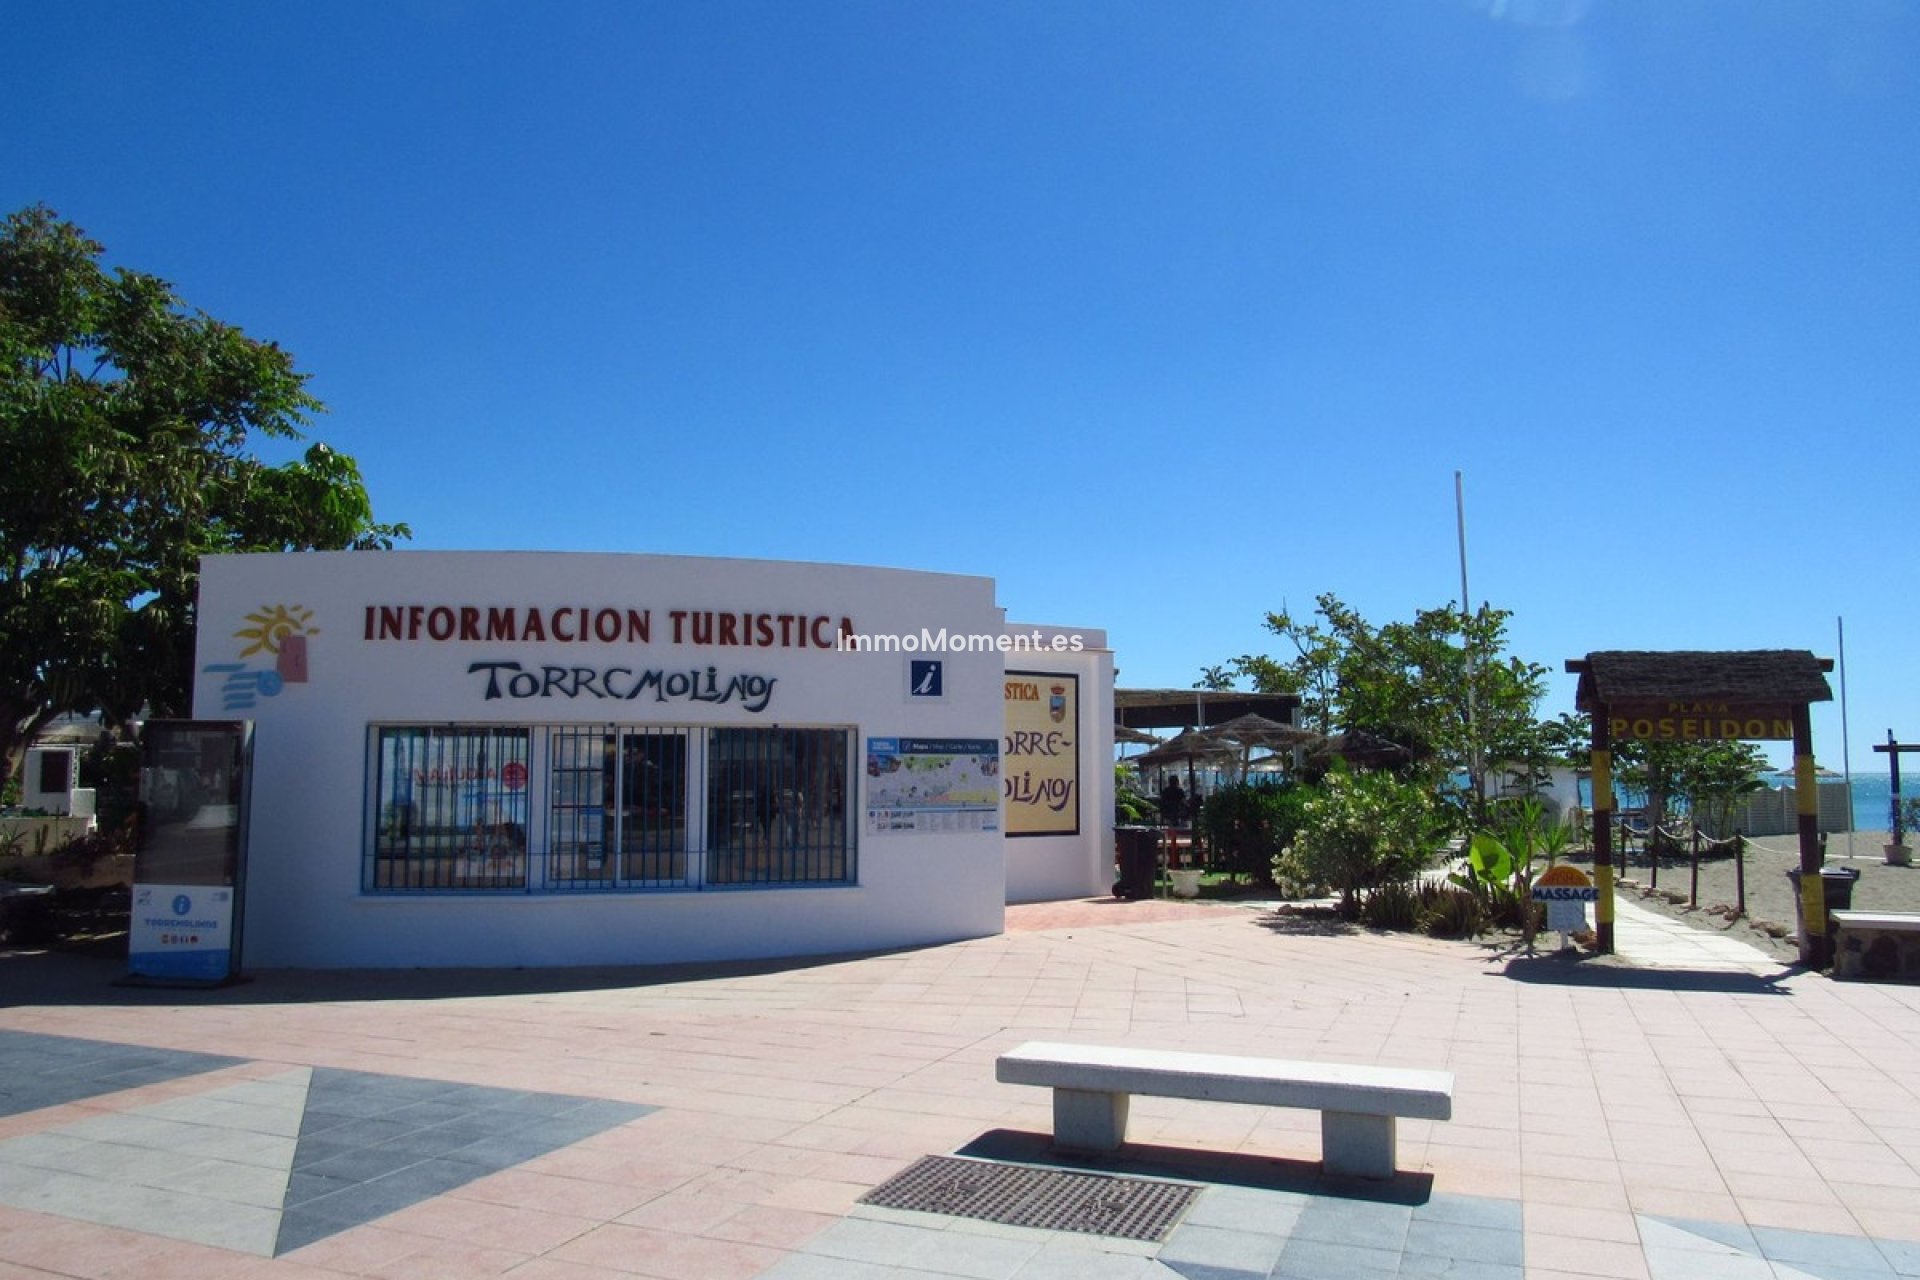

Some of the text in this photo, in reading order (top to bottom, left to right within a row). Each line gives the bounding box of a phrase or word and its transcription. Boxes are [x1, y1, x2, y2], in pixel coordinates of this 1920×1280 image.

[364, 605, 858, 649] INFORMACION TURISTICA
[1669, 703, 1728, 713] PLAYA
[1610, 719, 1794, 739] POSEIDON
[1532, 887, 1600, 900] MASSAGE
